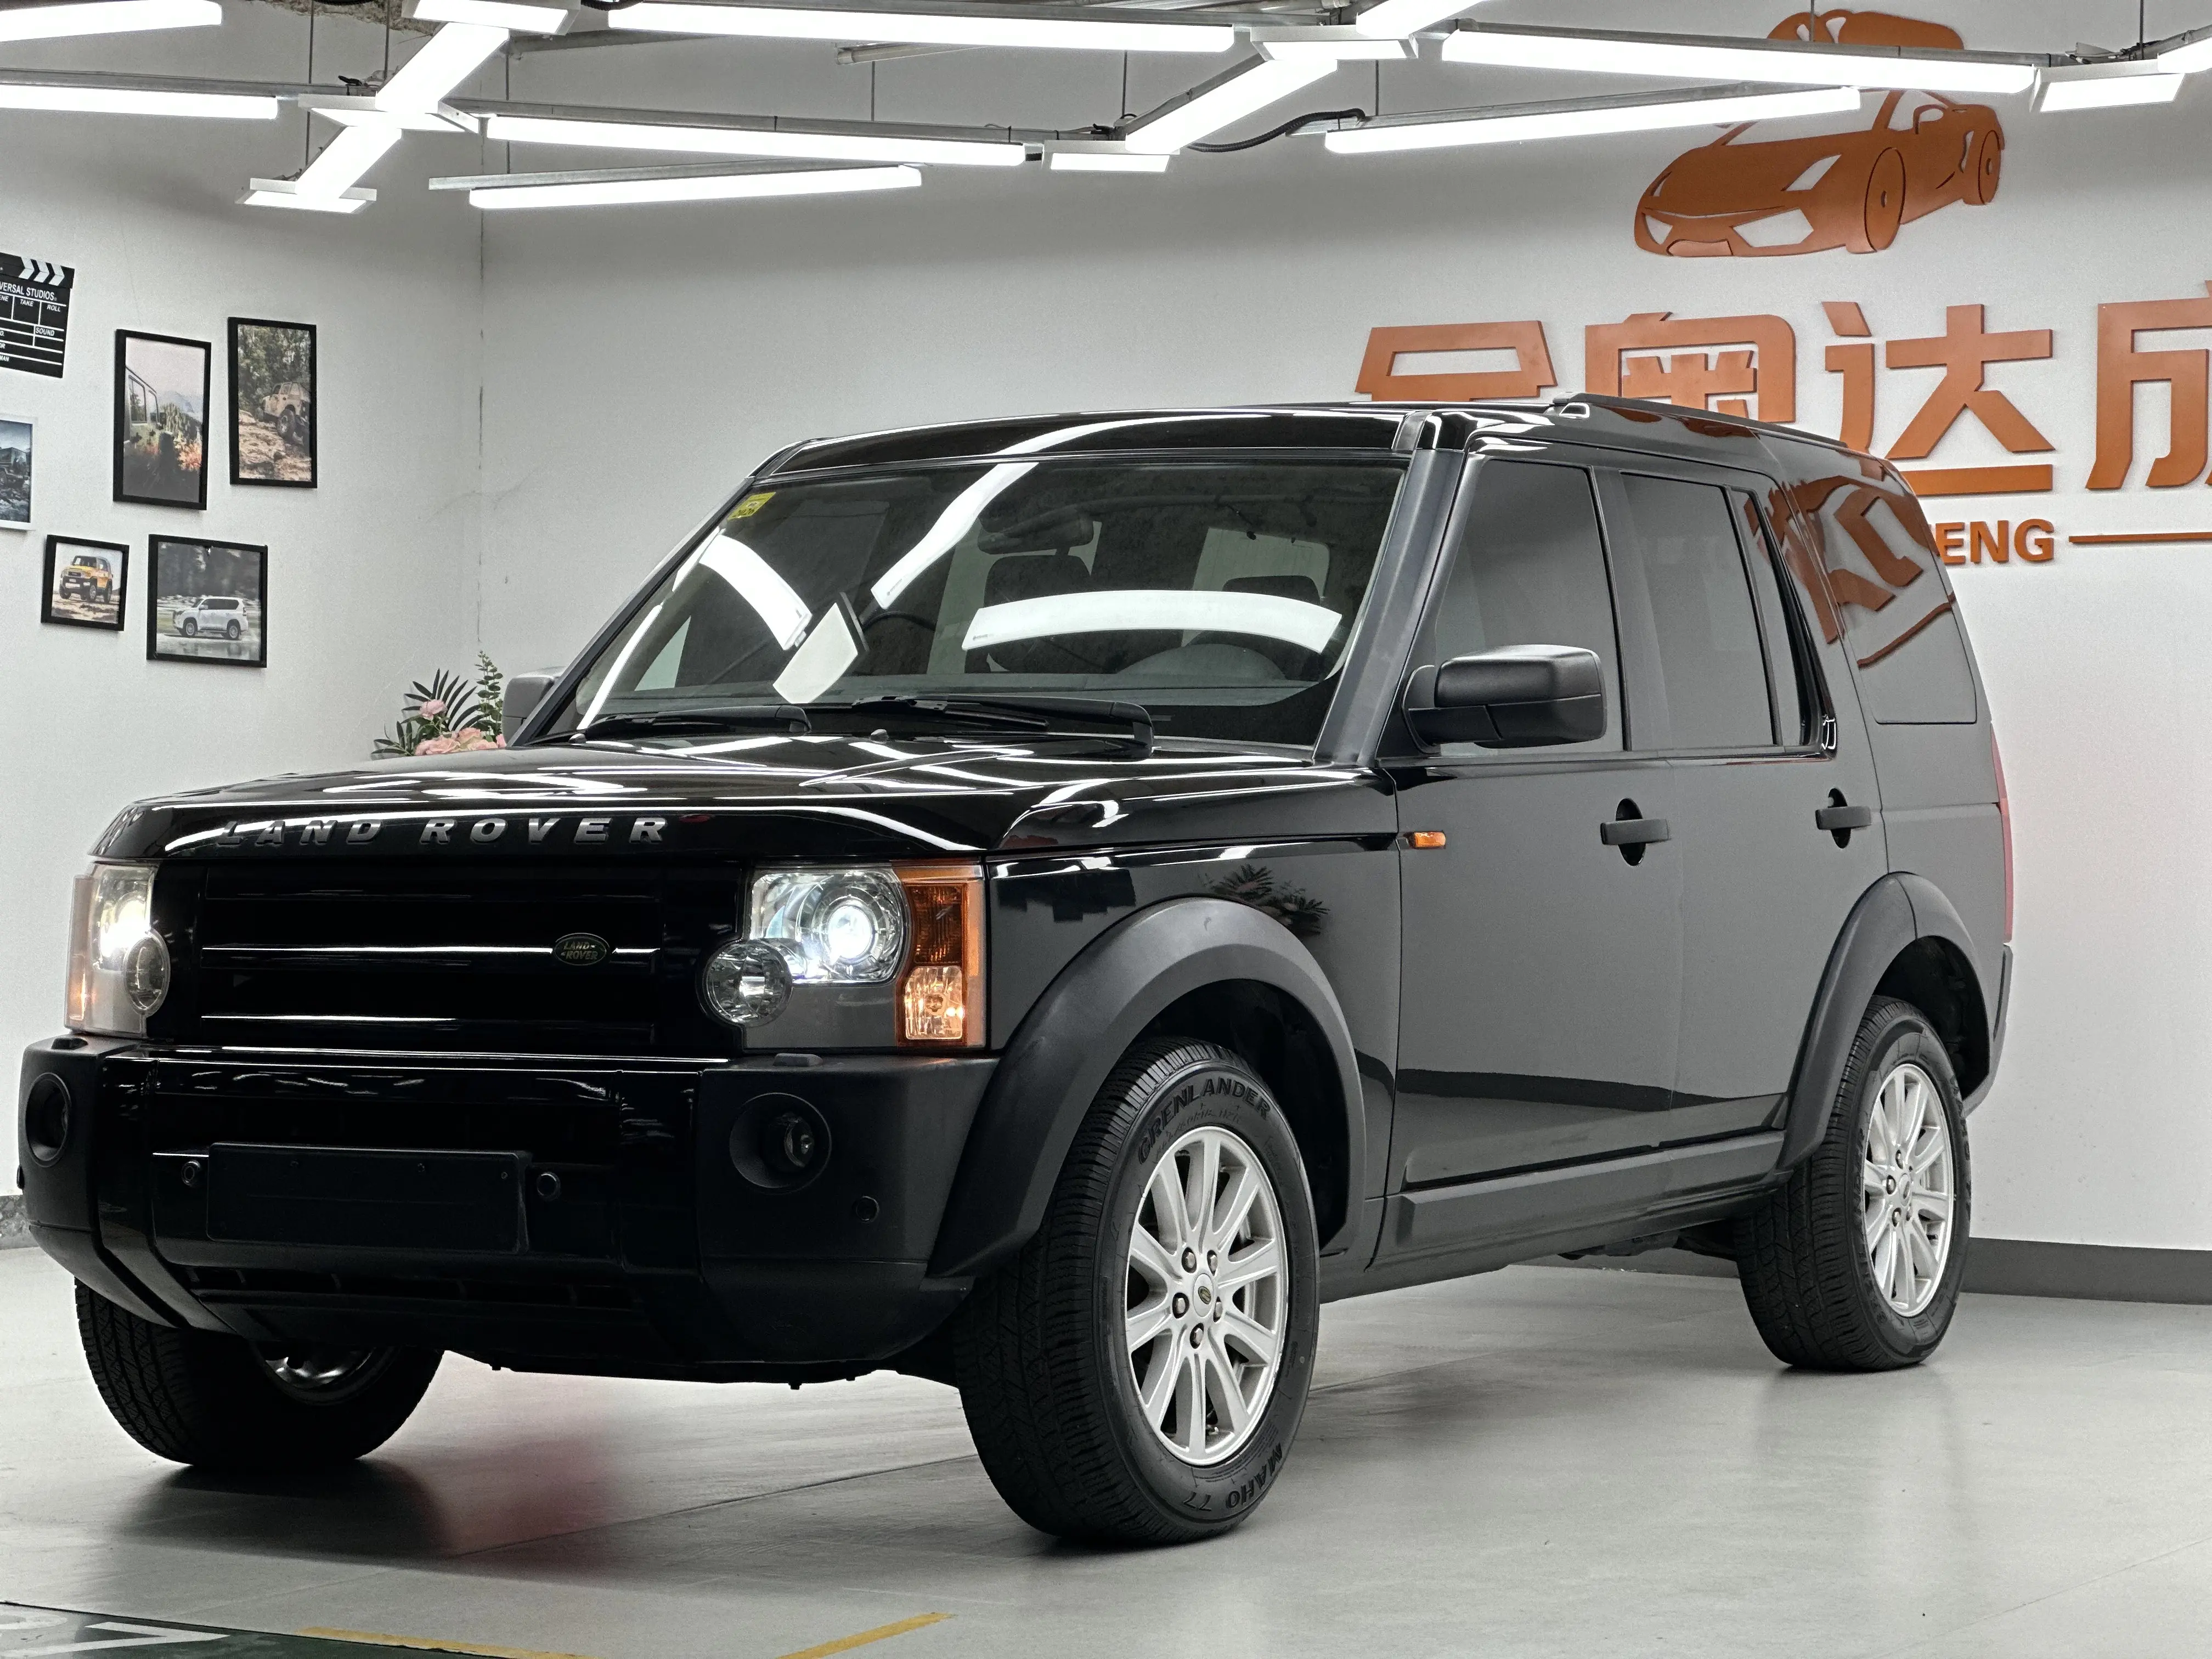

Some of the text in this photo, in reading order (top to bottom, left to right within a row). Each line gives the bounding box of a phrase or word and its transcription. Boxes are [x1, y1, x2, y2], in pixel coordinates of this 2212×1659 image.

[26, 287, 54, 301] STUDIOS
[20, 298, 34, 307] TAKE
[35, 327, 55, 336] SOUND
[1933, 518, 2055, 565] ENG
[217, 817, 668, 845] LAND ROVER
[563, 941, 590, 950] LAND
[566, 950, 599, 960] ROVER
[1138, 1076, 1272, 1165] GRENLANDER
[1226, 1442, 1283, 1509] MAHO
